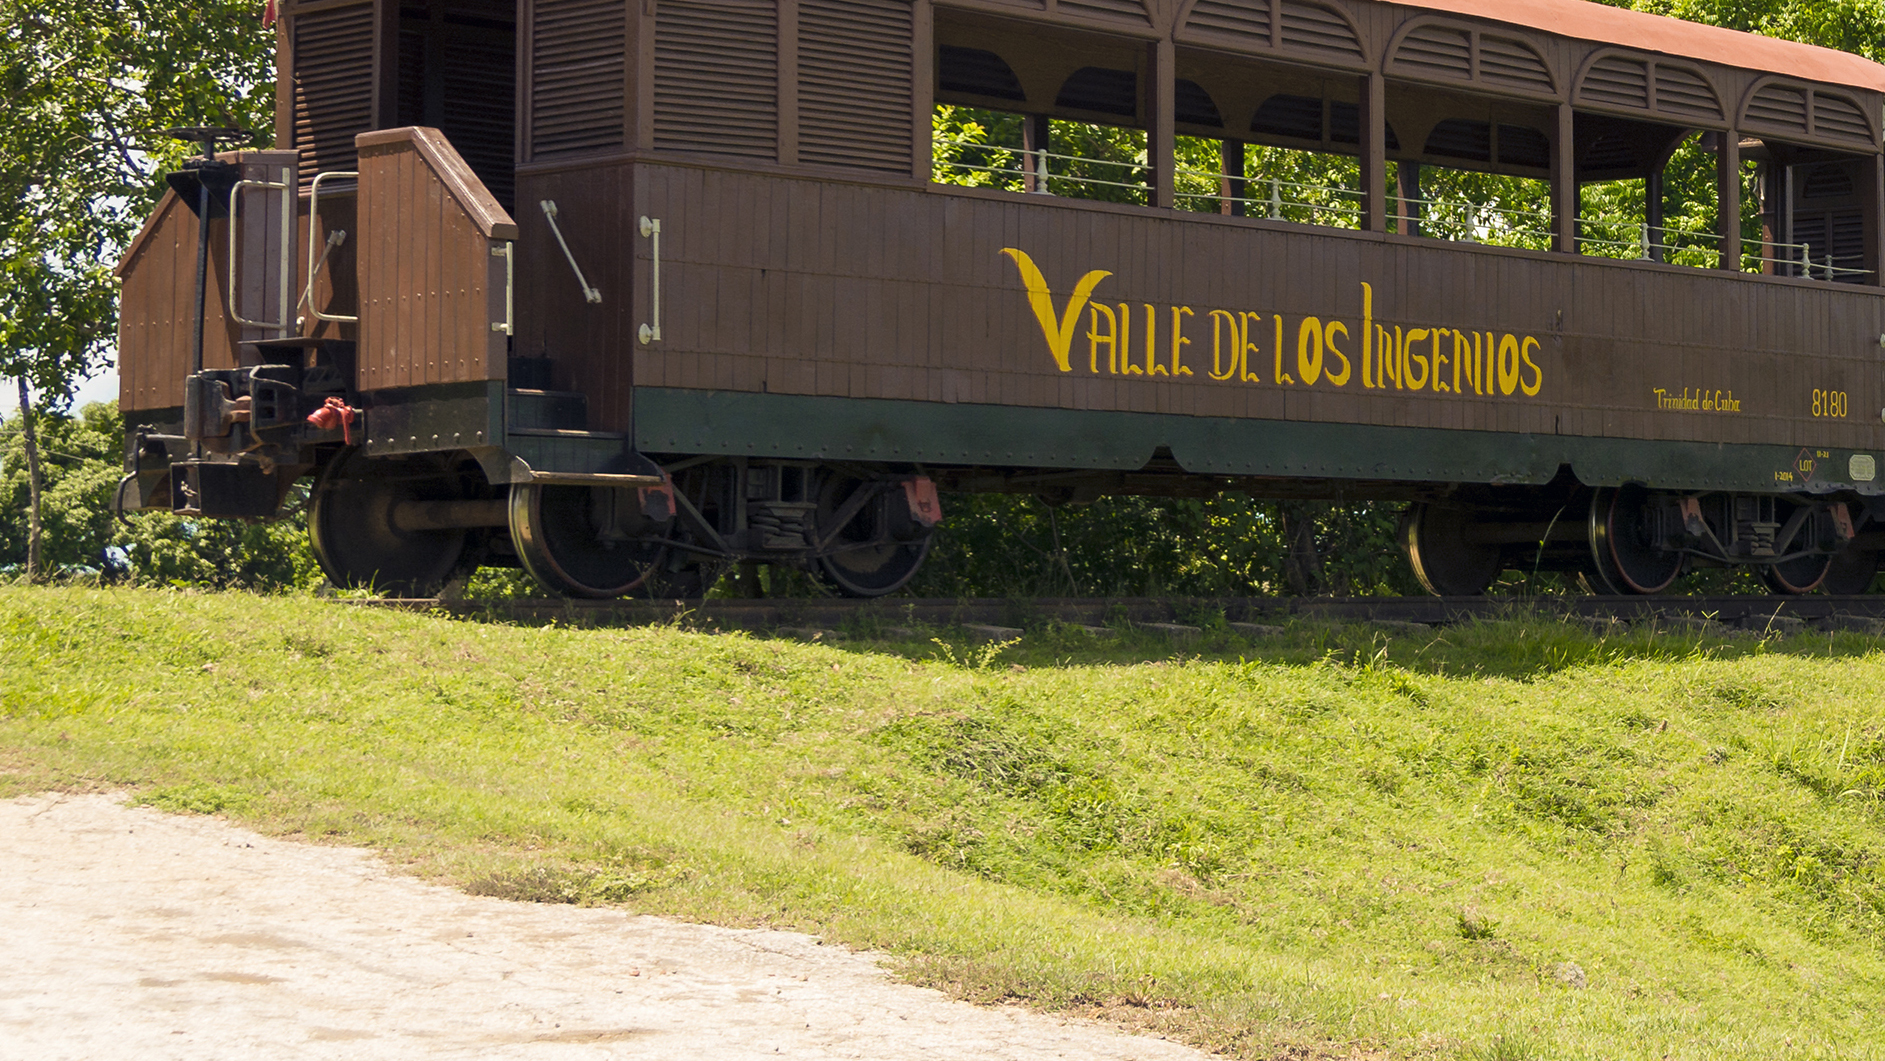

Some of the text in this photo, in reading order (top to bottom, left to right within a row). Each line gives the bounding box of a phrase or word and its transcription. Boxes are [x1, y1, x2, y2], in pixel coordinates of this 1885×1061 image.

[999, 247, 1543, 396] VALLE DE LOS INGENIOS
[1653, 387, 1741, 412] Trinidad de Cuba
[1811, 388, 1848, 418] 8180
[1799, 460, 1813, 472] LOT
